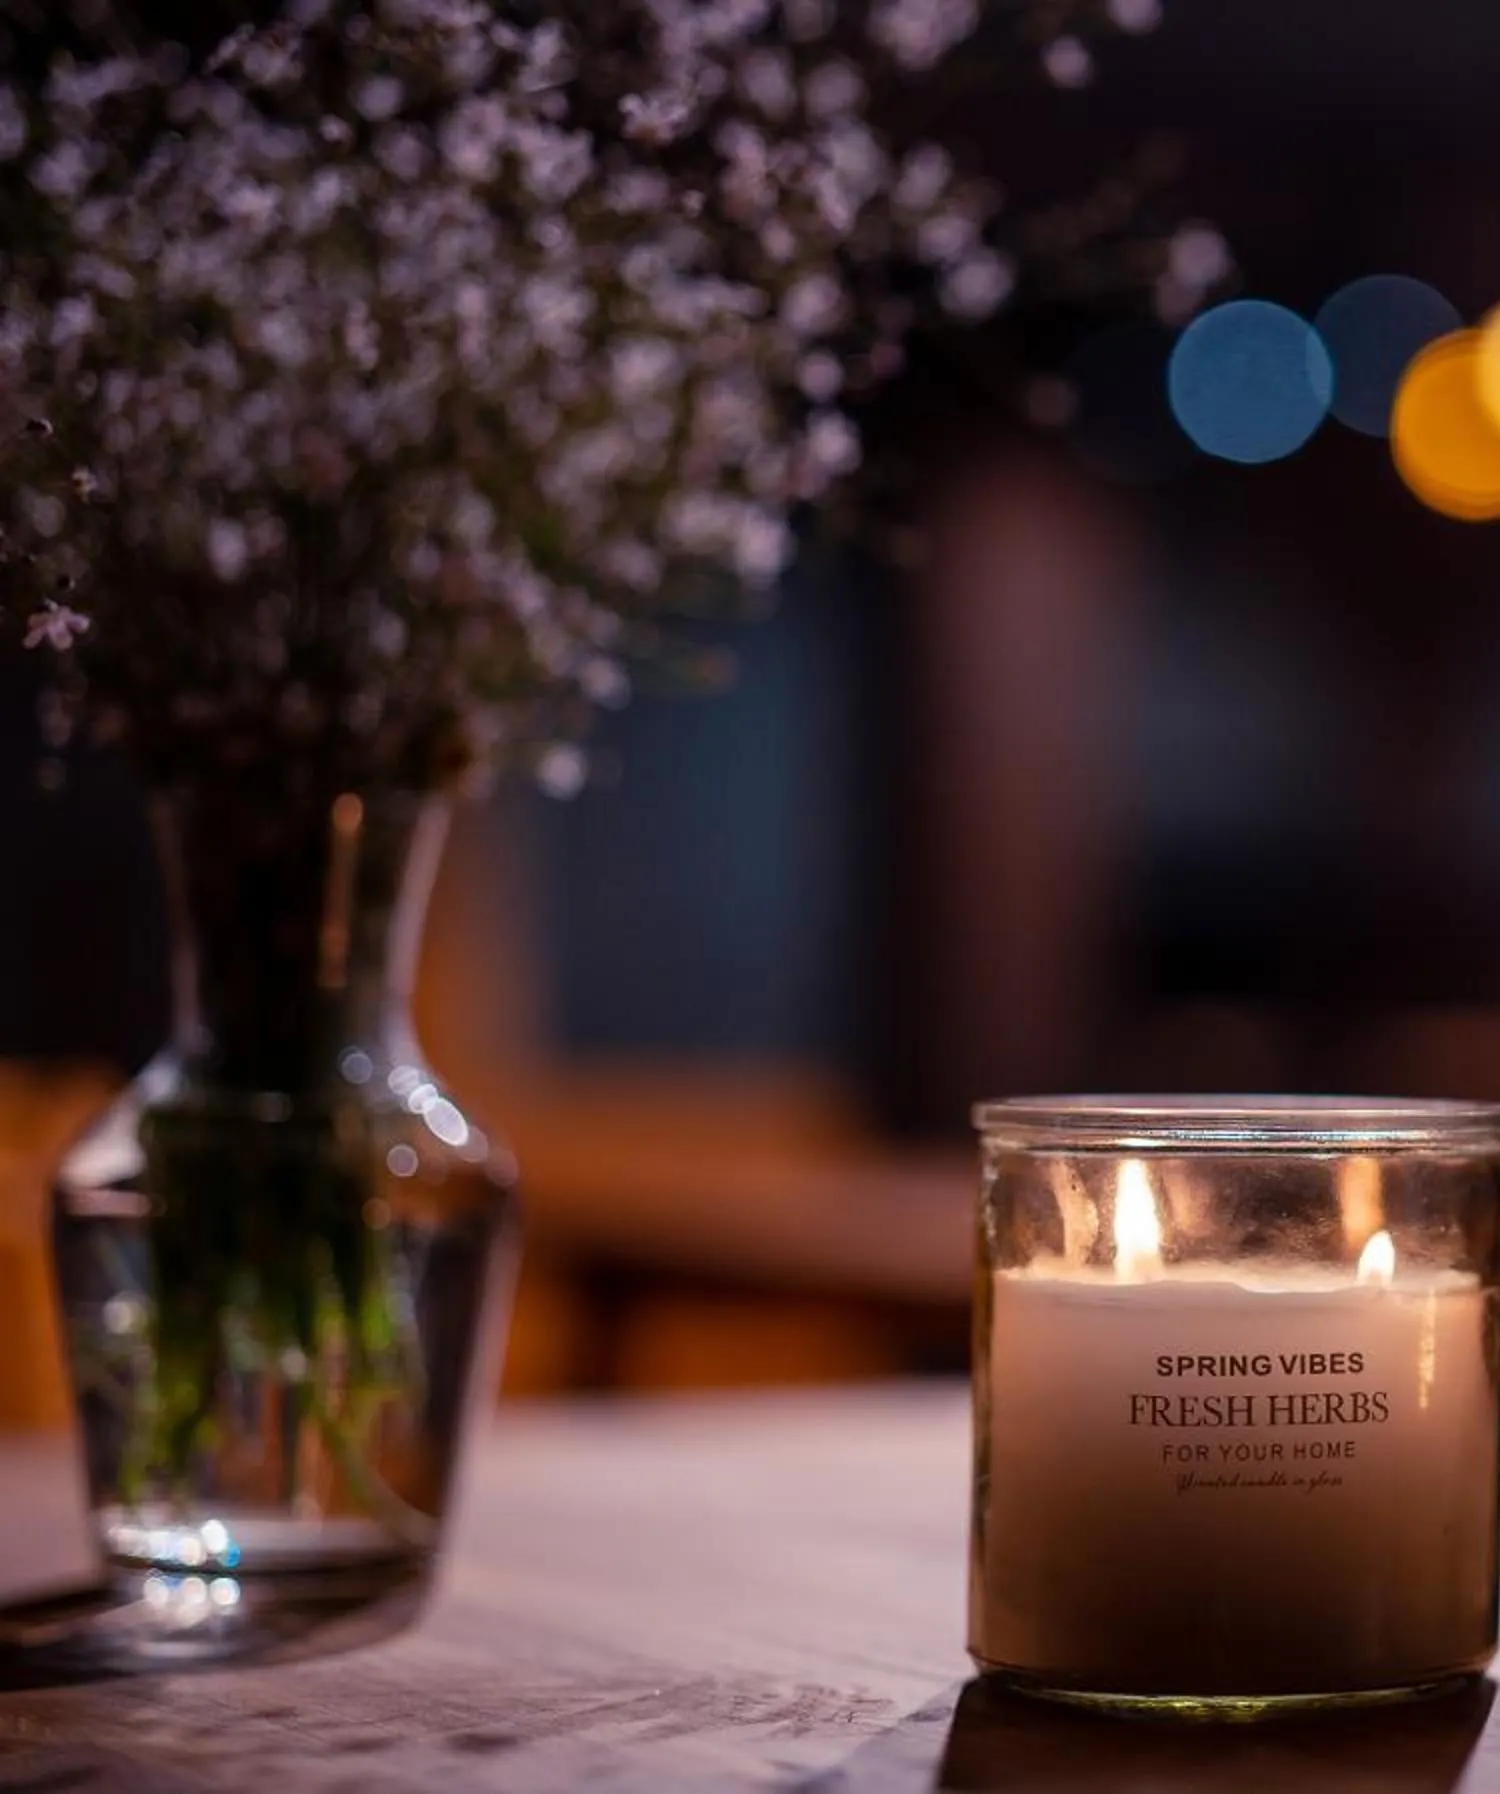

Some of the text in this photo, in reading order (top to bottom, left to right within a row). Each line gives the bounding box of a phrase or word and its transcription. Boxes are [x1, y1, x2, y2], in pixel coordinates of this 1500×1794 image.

[1156, 1353, 1364, 1377] SPRING VIBES
[1129, 1391, 1389, 1427] FRESH HERBS
[1162, 1441, 1356, 1463] FOR YOUR HOME
